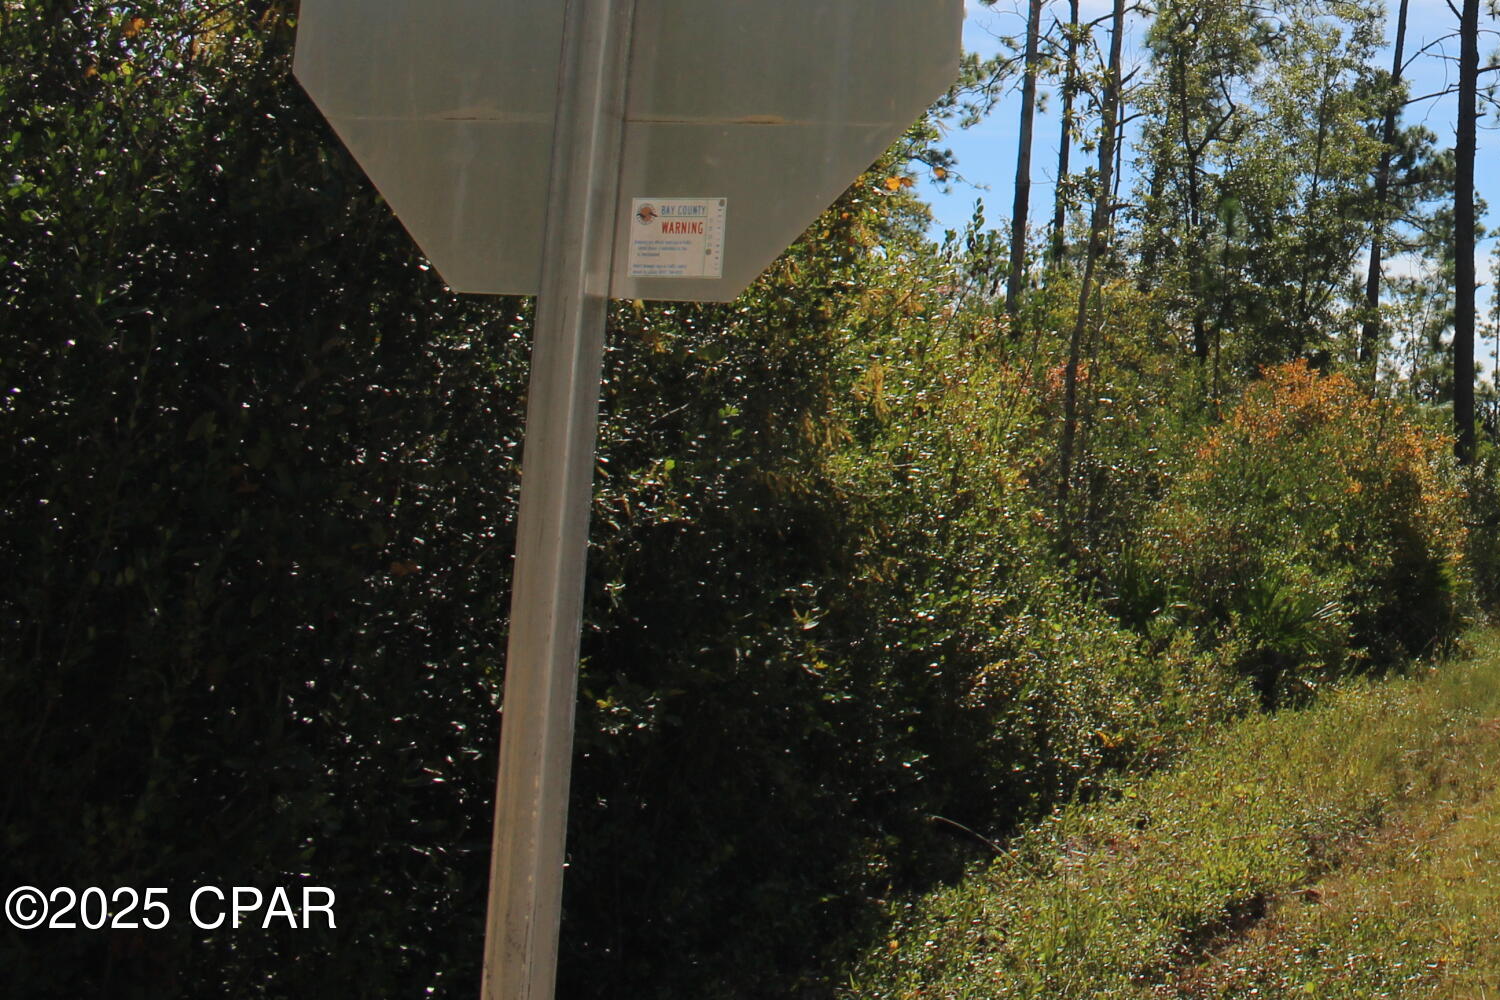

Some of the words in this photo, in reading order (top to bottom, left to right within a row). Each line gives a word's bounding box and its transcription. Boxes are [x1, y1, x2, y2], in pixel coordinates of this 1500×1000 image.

[661, 205, 675, 216] BAY
[677, 205, 706, 216] COUNTY
[661, 221, 704, 235] WARNING
